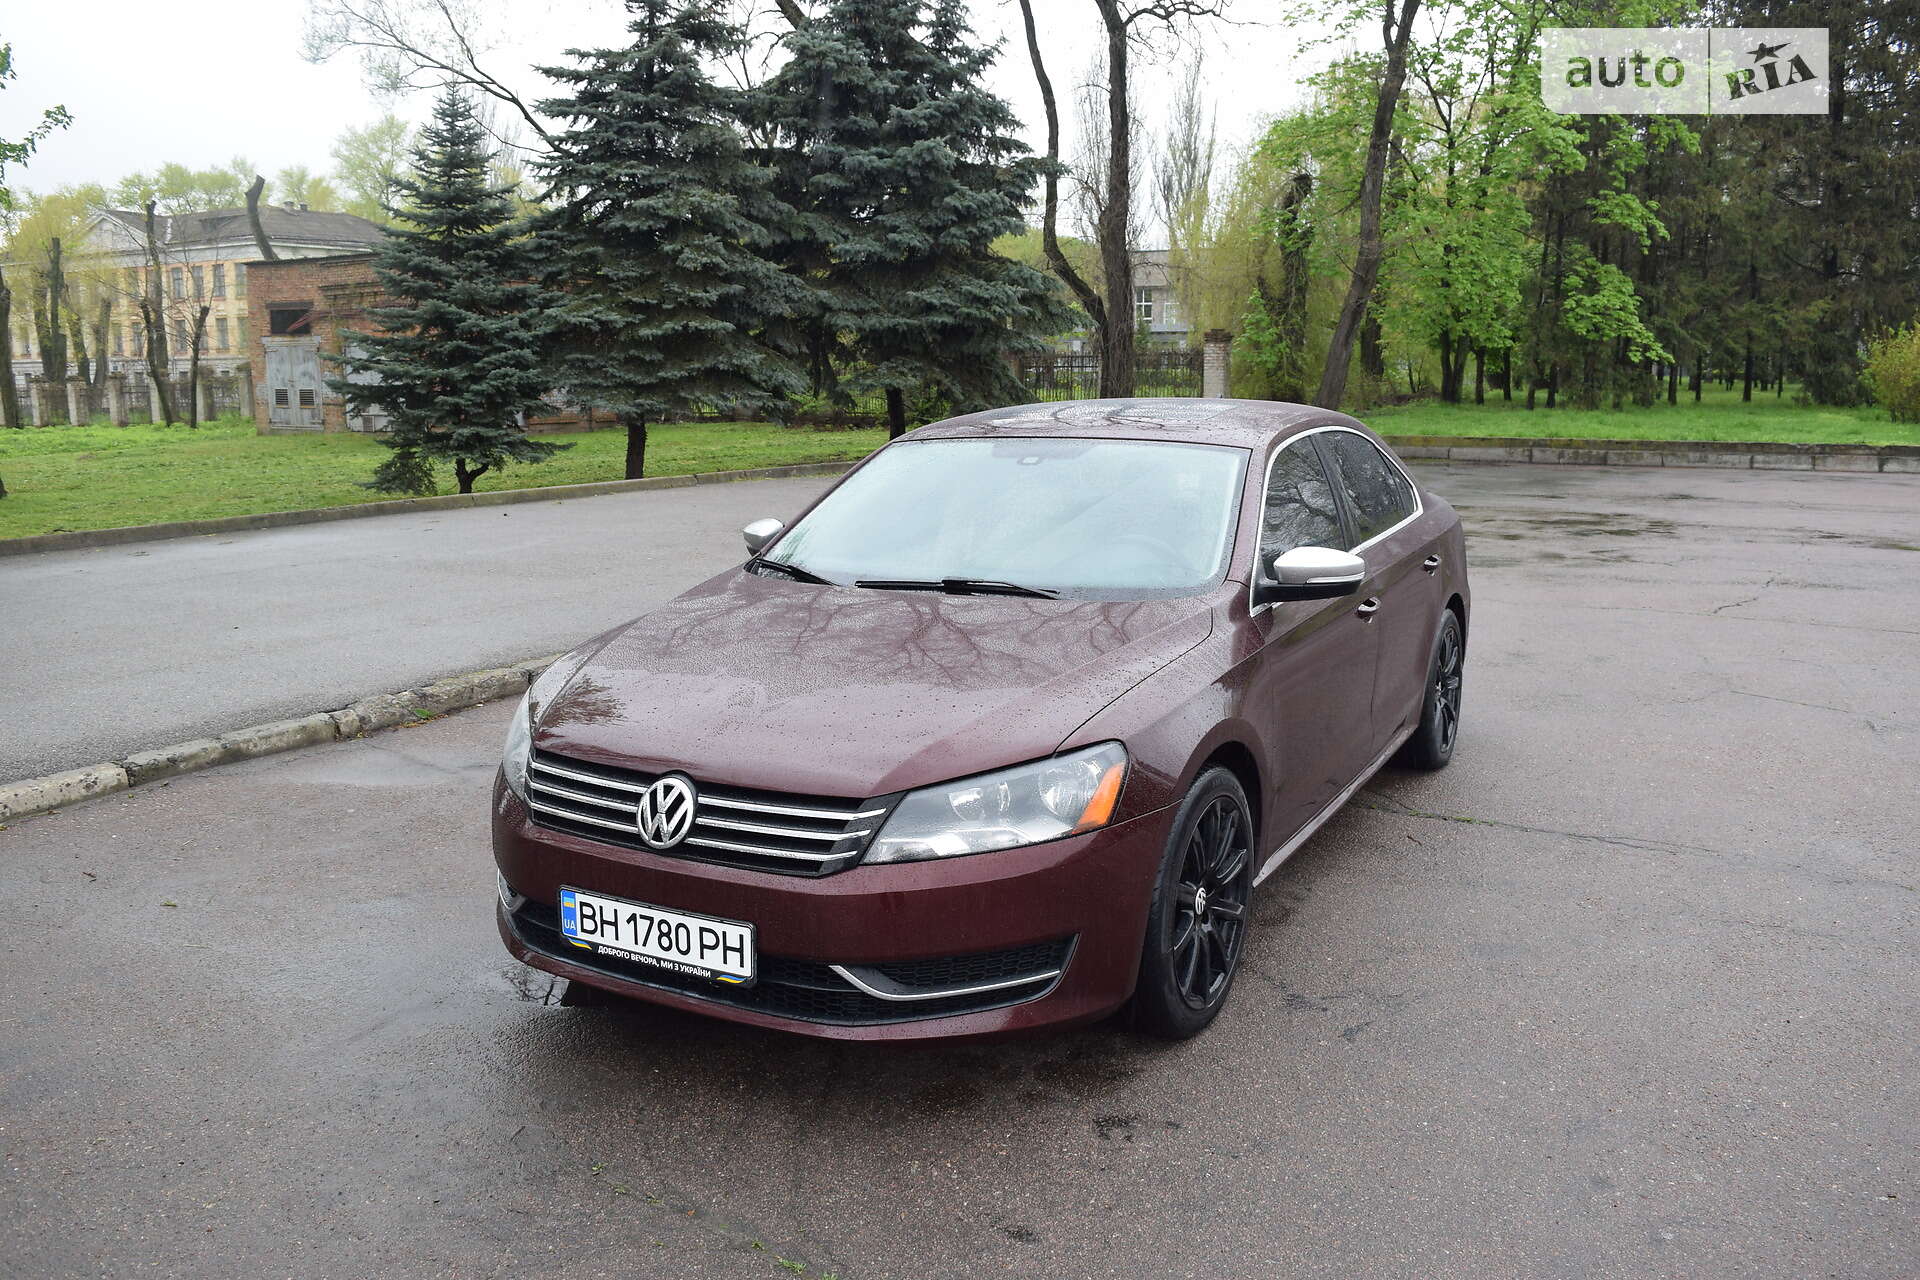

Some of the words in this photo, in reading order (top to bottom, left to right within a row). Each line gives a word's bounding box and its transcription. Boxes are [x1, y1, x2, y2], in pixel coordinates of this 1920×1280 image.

[564, 918, 576, 931] UA
[579, 901, 619, 941] BH
[626, 912, 691, 956] 1780
[699, 926, 745, 969] PH
[598, 945, 630, 959] ДОБРОГО
[630, 953, 660, 968] ВЕЧОРА,
[660, 959, 673, 970] МИ
[679, 964, 711, 978] УКРАЇНИ
